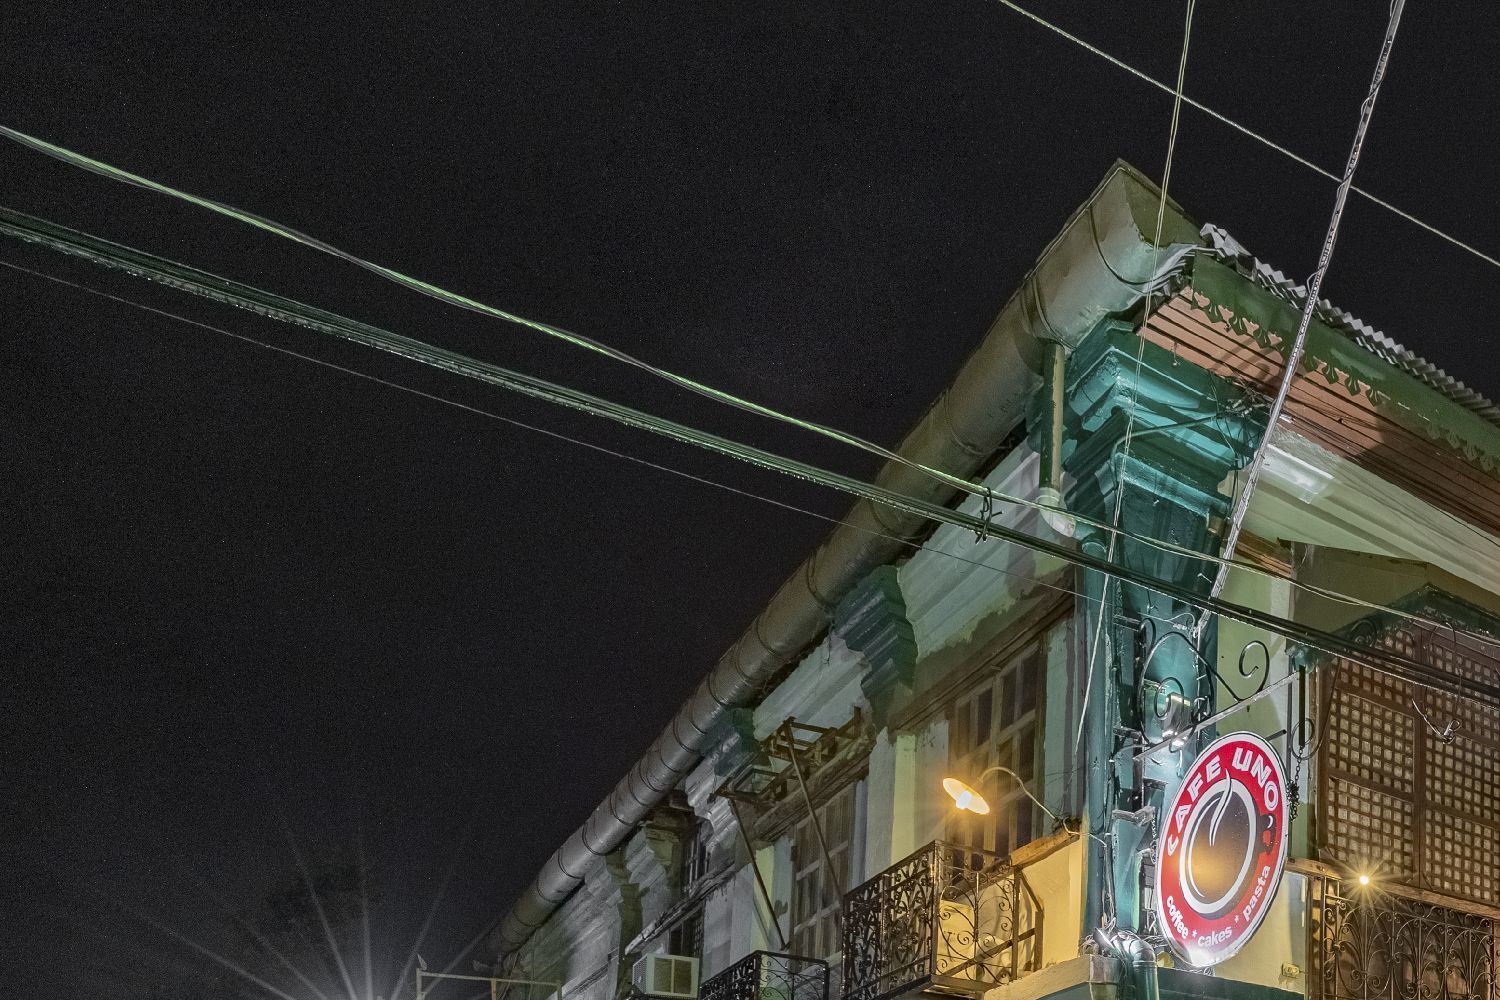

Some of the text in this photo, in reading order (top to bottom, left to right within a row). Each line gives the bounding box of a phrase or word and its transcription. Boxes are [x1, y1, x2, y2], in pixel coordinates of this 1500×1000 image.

[1166, 746, 1279, 856] CAFE UNO
[1166, 895, 1233, 947] coffee cakes
[1242, 865, 1271, 922] pasta
